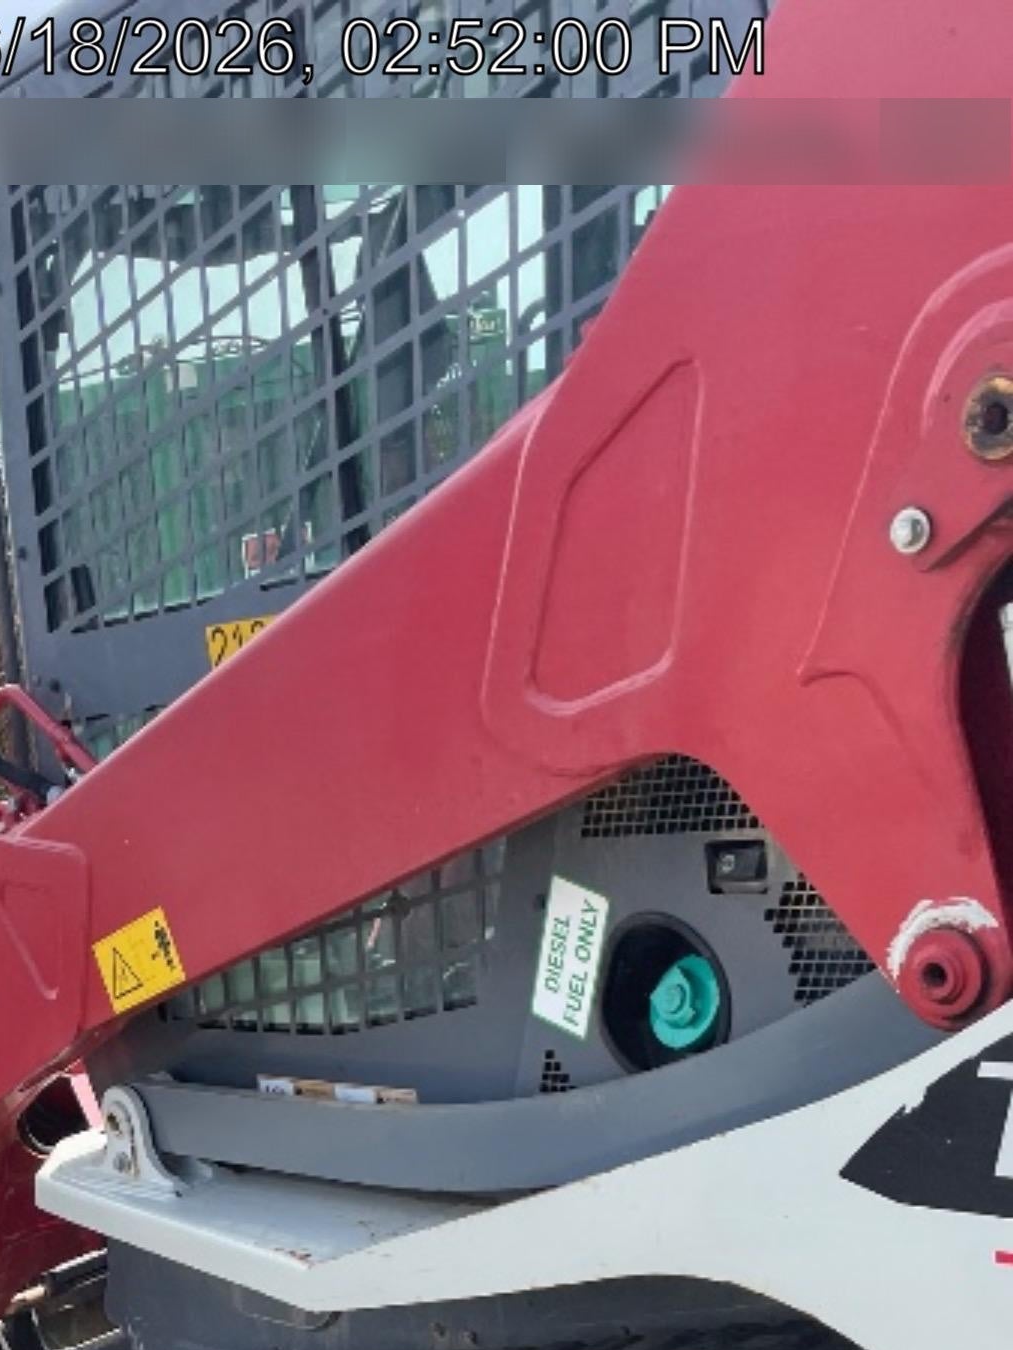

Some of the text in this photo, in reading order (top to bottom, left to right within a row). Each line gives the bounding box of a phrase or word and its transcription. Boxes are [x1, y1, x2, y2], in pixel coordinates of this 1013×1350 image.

[544, 916, 570, 994] DIESEL
[562, 898, 600, 1027] FUEL ONLY
